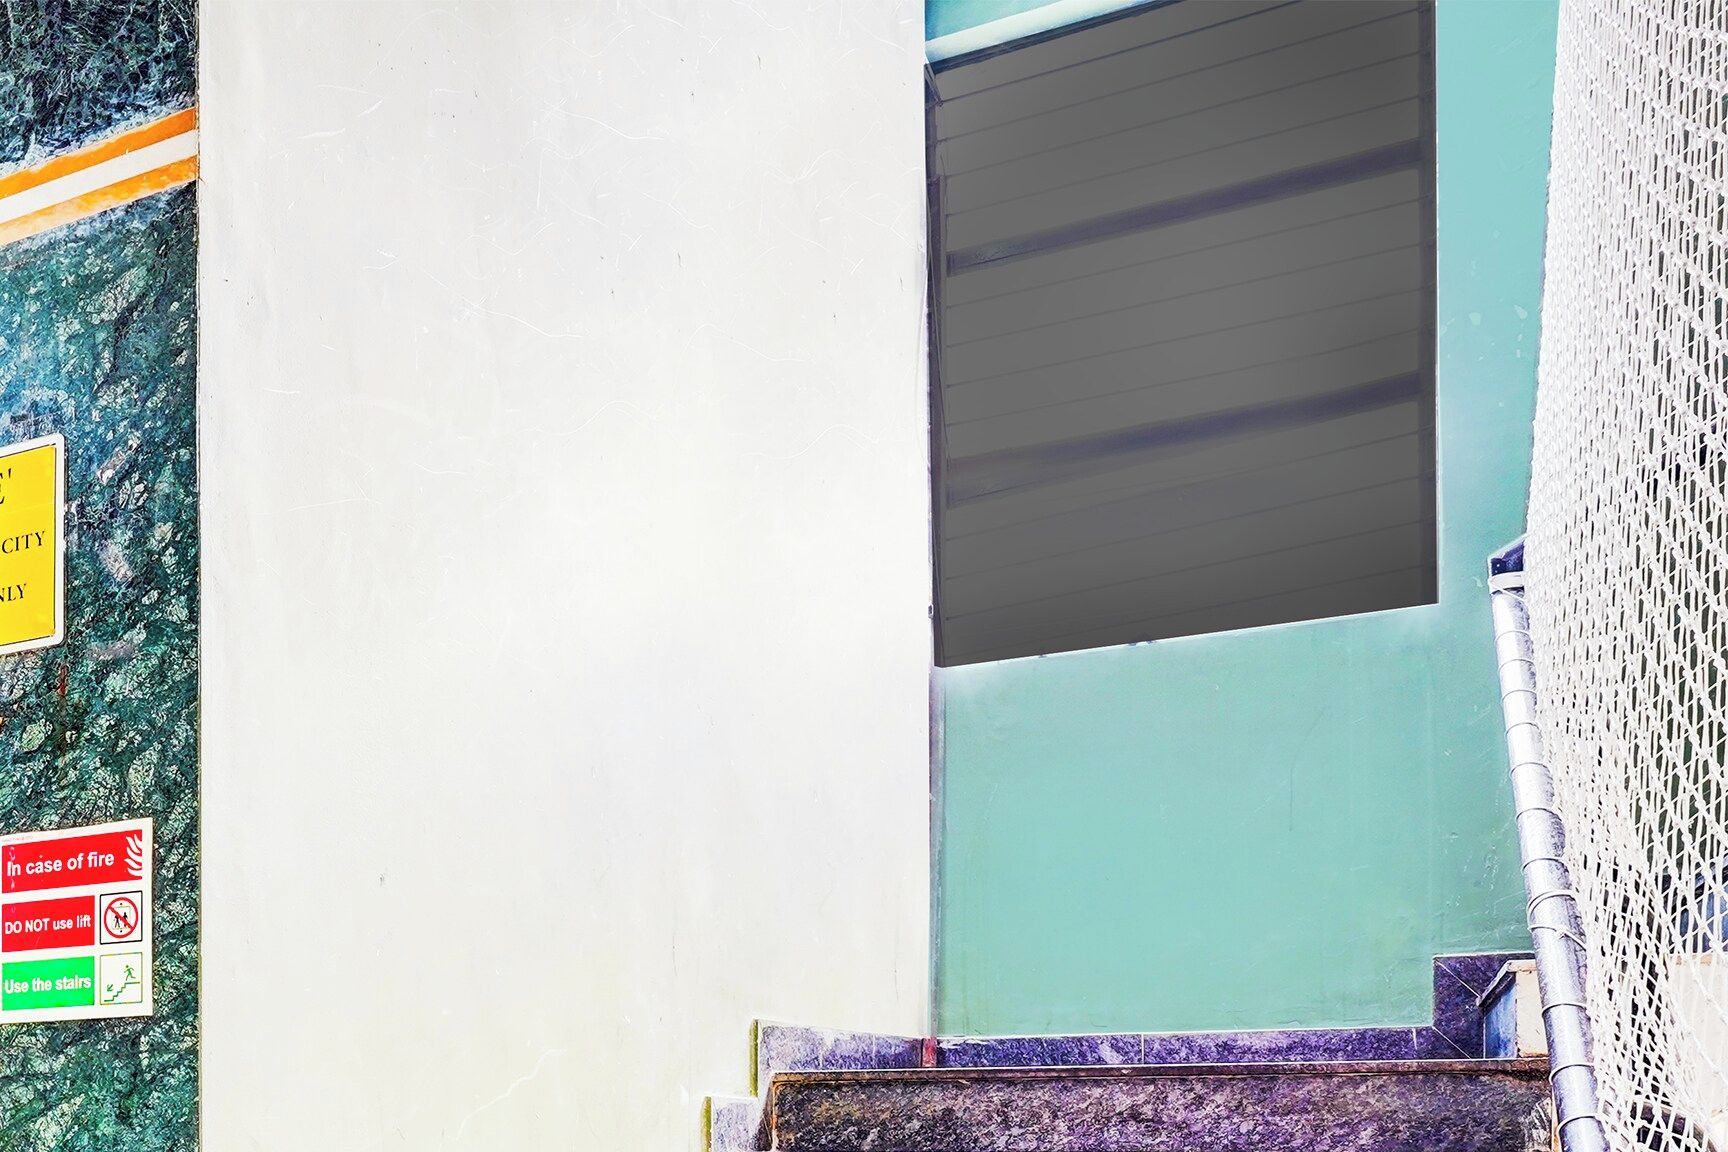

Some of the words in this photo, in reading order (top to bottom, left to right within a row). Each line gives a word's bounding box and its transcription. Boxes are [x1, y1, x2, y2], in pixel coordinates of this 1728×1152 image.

[7, 861, 21, 876] In
[25, 859, 62, 874] case
[67, 852, 84, 870] of
[87, 851, 115, 868] fire
[4, 921, 22, 935] DO
[25, 918, 50, 932] NOT
[53, 919, 73, 930] use
[76, 914, 91, 928] lift
[4, 979, 29, 994] Use
[32, 977, 52, 992] the
[55, 974, 91, 990] stairs
